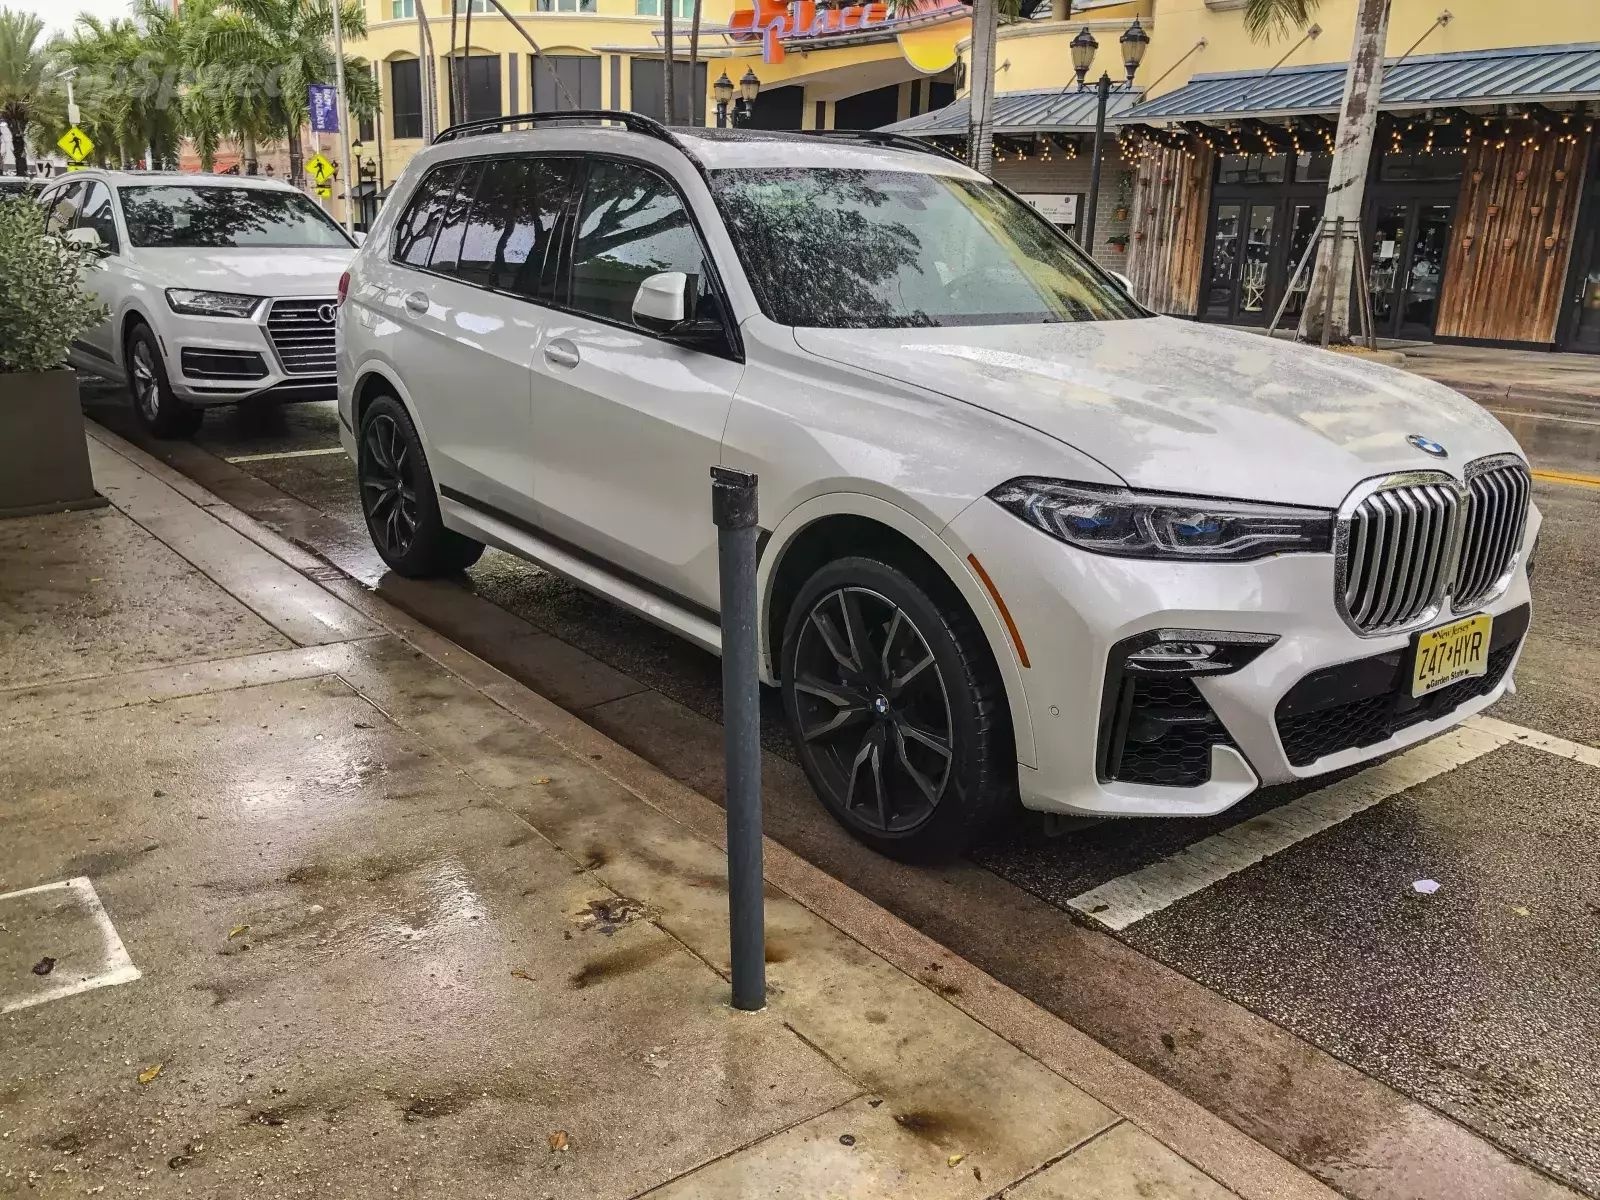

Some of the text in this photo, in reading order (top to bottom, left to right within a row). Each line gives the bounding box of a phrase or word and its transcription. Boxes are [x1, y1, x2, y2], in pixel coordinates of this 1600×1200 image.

[314, 92, 325, 130] HOLIDAYS
[1430, 669, 1465, 688] Garden State
